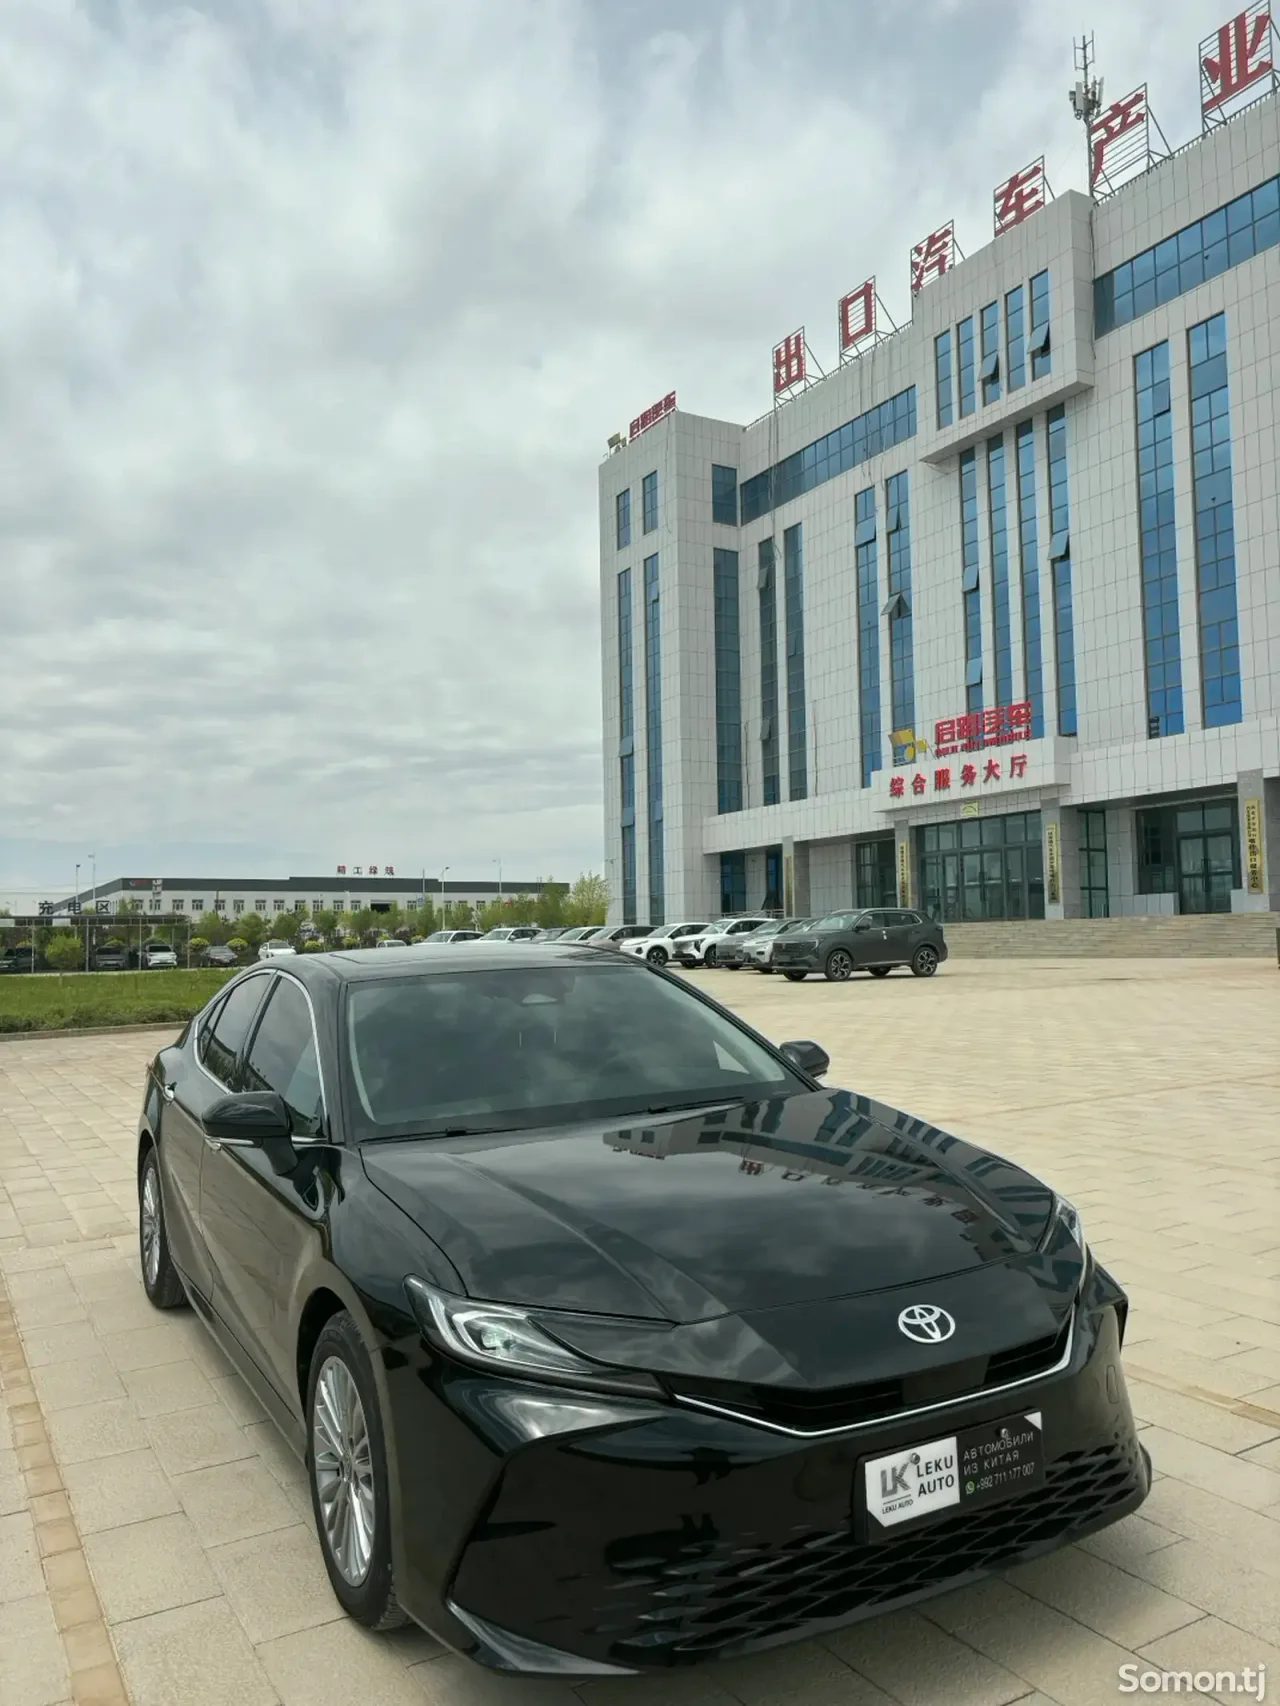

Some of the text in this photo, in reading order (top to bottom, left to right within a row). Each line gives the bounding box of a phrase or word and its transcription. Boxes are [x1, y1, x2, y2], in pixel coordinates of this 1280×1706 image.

[889, 753, 1028, 798] 综合服务大厅
[38, 900, 111, 915] 充电区
[963, 1431, 1034, 1461] АВТОМОБИЛИ
[917, 1455, 953, 1478] LEKU
[963, 1450, 1020, 1476] ИЗ КИТАЯ
[918, 1474, 955, 1498] AUTO
[882, 1498, 914, 1515] LEKU AUTO
